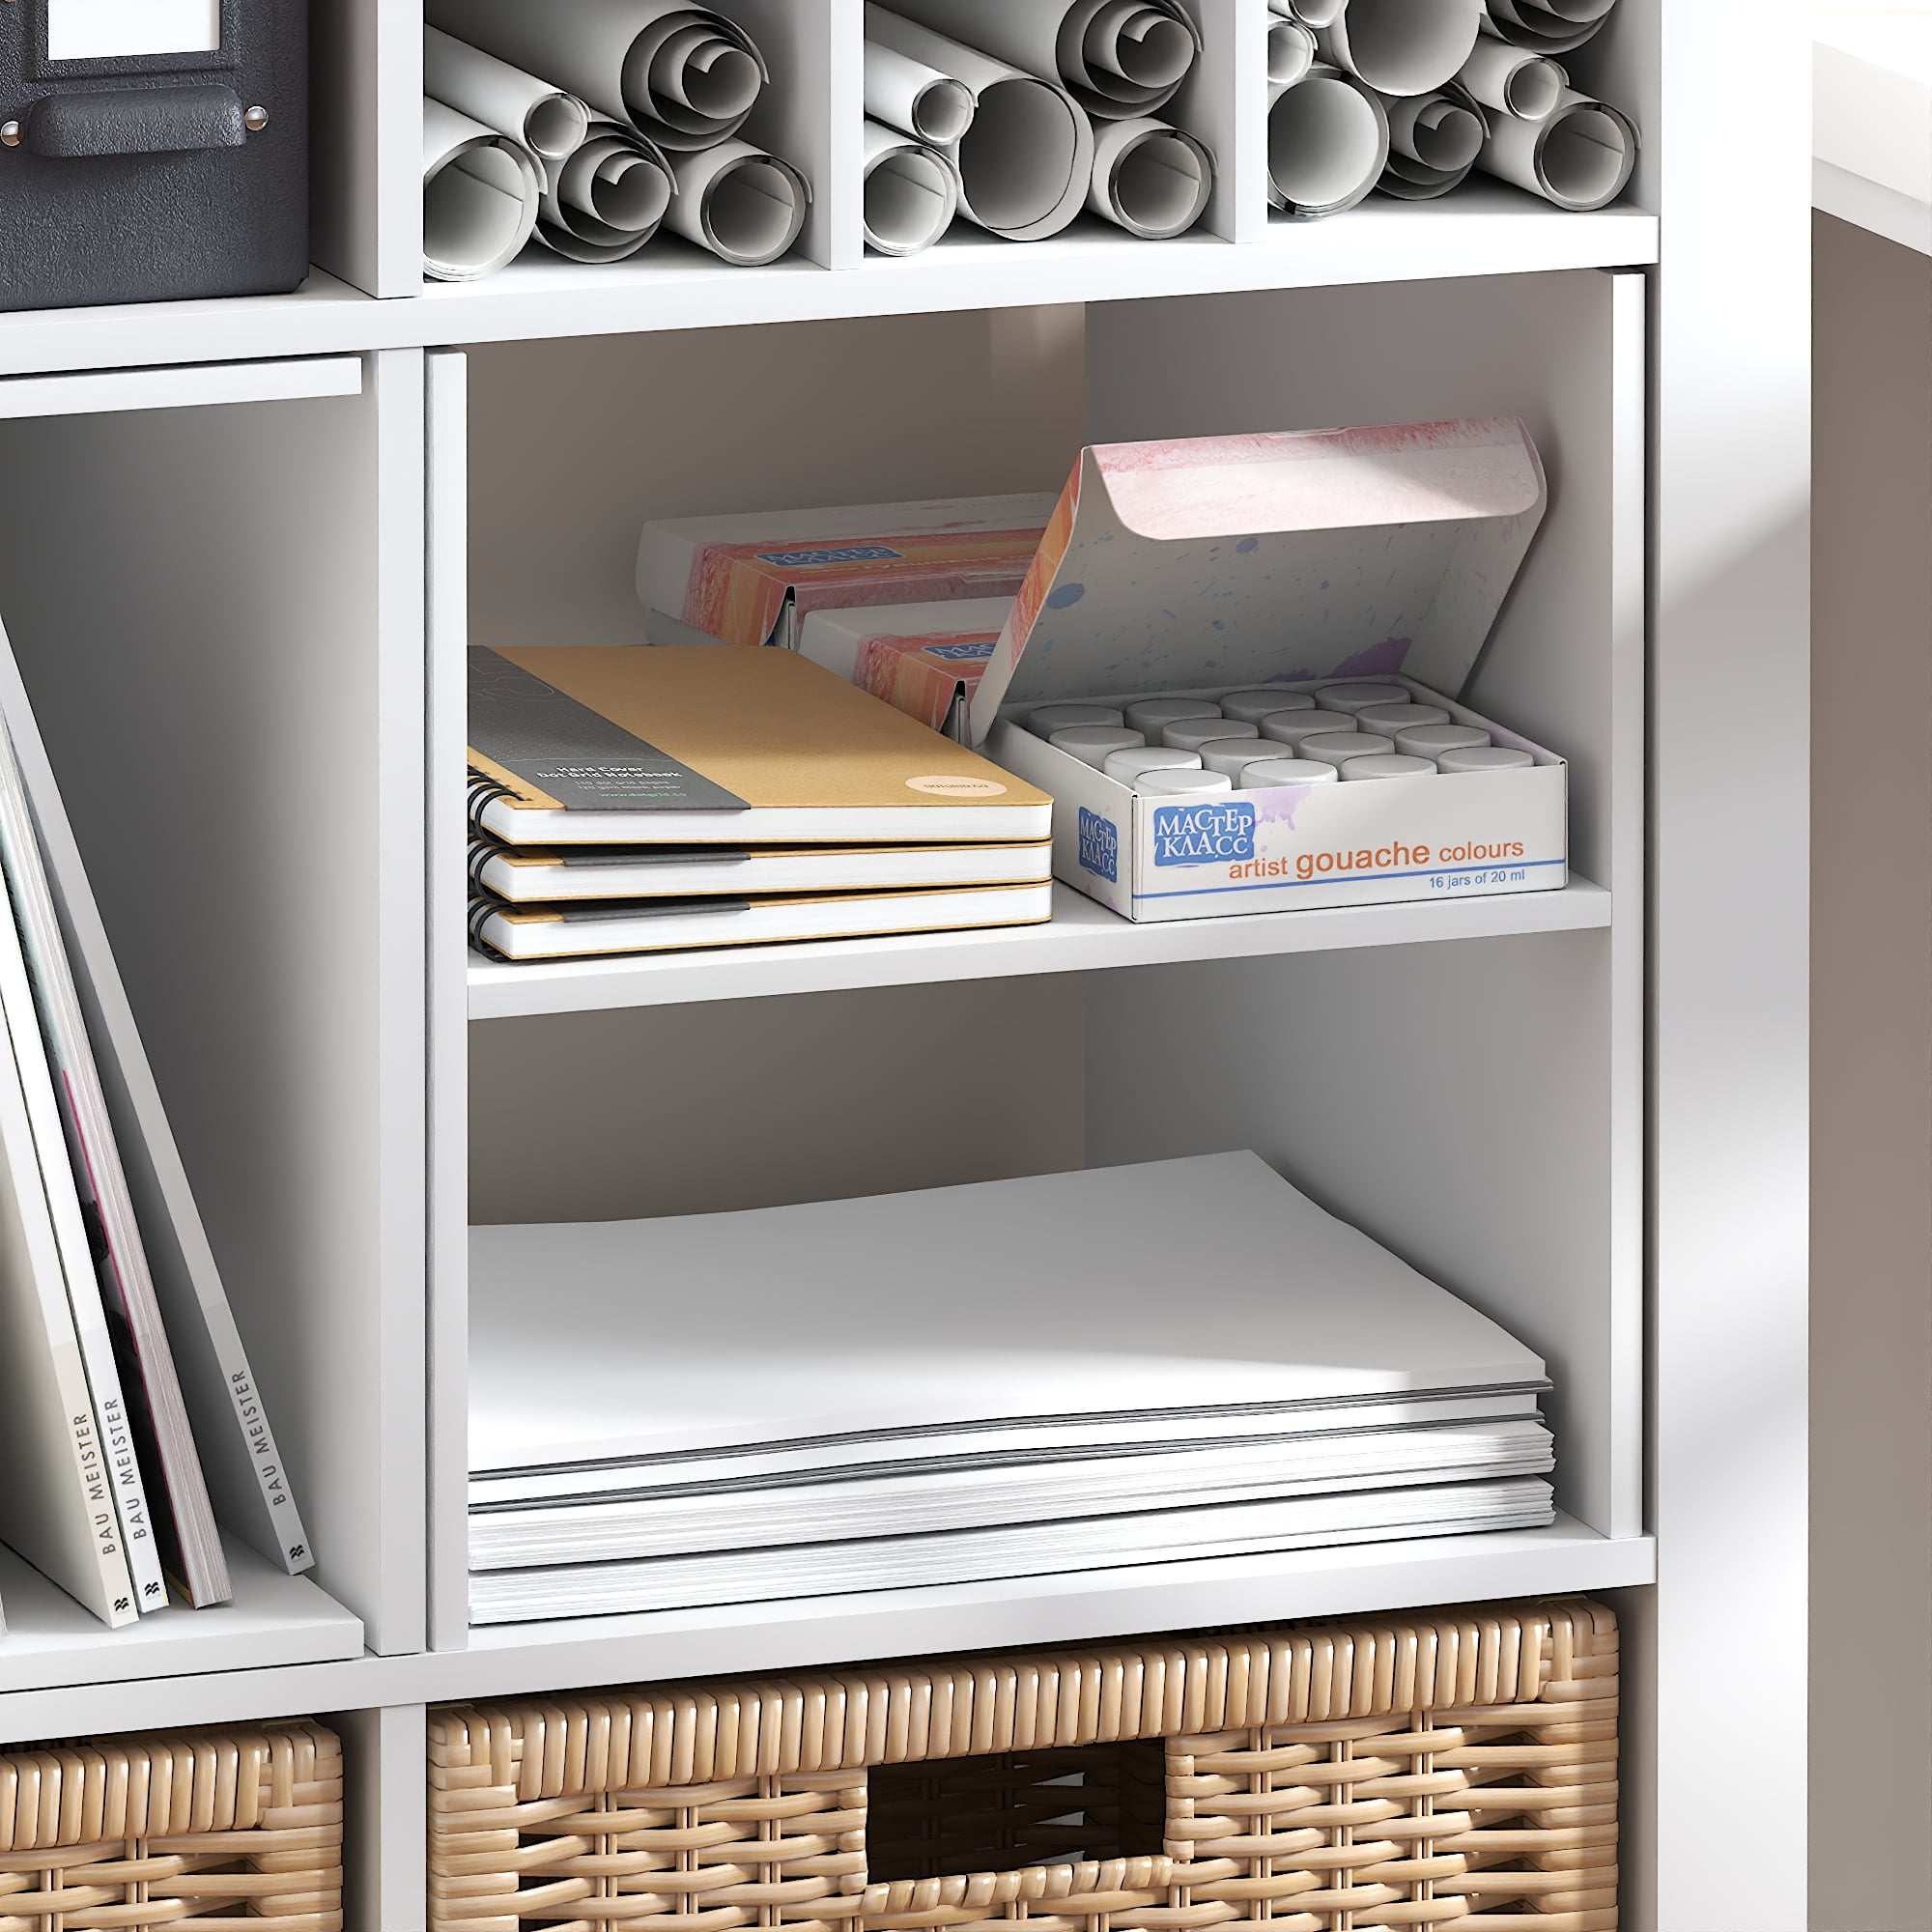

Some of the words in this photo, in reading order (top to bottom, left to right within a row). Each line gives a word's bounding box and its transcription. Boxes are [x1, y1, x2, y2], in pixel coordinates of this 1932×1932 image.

[1080, 815, 1117, 857] МАСТЕР
[1156, 809, 1253, 837] МАСТЕР
[1162, 832, 1248, 858] КЛАСС
[1229, 857, 1289, 879] artist
[1295, 840, 1430, 880] gouache
[1438, 841, 1524, 863] colours
[1430, 876, 1444, 889] 16
[1447, 875, 1471, 890] jars
[1475, 872, 1488, 884] of
[1491, 870, 1506, 883] 20
[1511, 868, 1525, 881] ml
[231, 1370, 270, 1455] MEISTER
[73, 1413, 104, 1500] MEISTER
[104, 1398, 135, 1486] MEISTER
[264, 1464, 287, 1506] BAU
[95, 1512, 116, 1555] BAU
[128, 1498, 147, 1540] BAU
